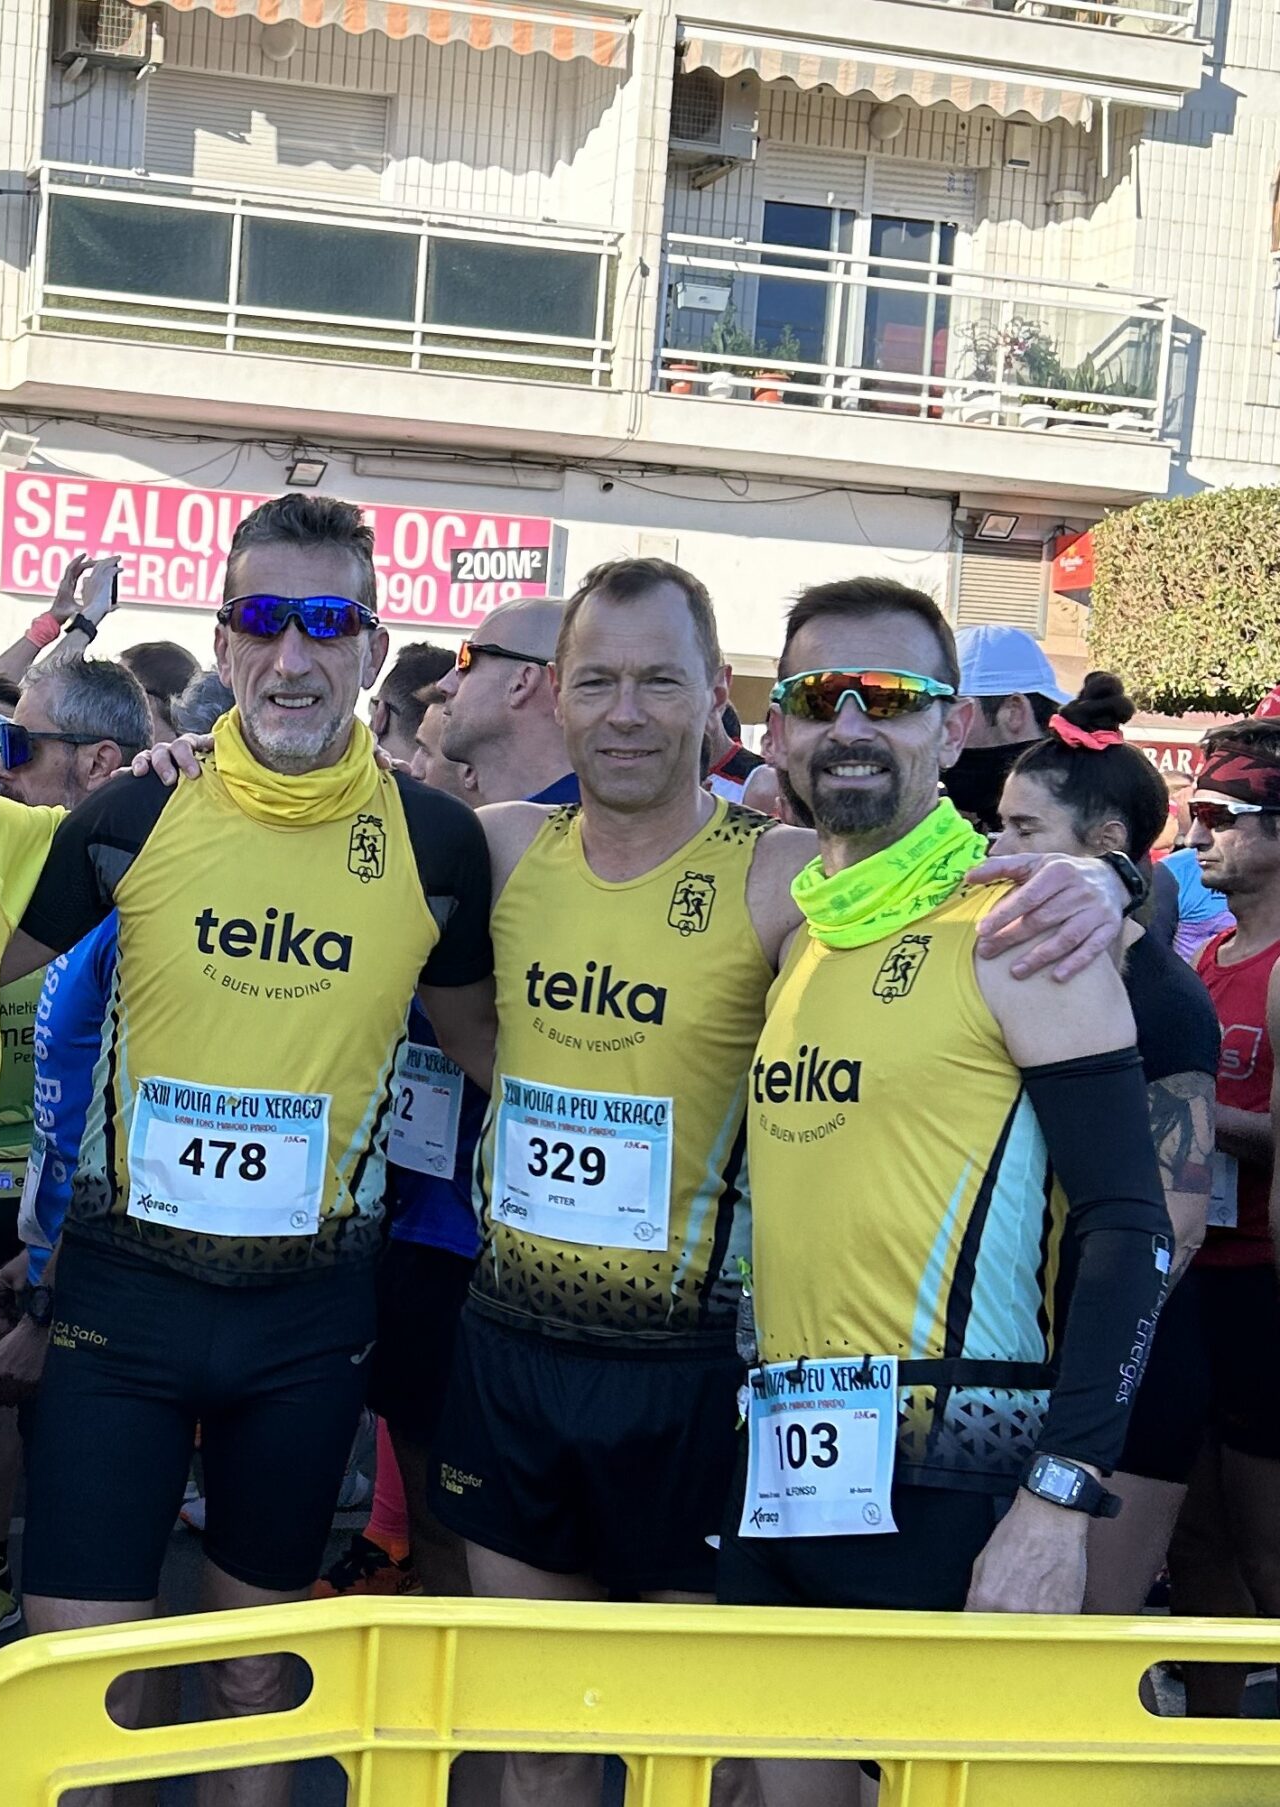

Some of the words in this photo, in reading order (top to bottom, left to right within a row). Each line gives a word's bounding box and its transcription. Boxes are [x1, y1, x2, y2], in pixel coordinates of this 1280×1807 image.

[14, 479, 89, 542] SE
[194, 907, 354, 973] teika
[901, 934, 933, 945] CAS
[202, 963, 218, 981] EL
[221, 975, 260, 997] BUEN
[264, 978, 332, 1000] VENDING
[525, 961, 668, 1026] teika
[532, 1017, 545, 1034] EL
[547, 1028, 582, 1050] BUEN
[586, 1031, 646, 1052] VENDING
[753, 1044, 863, 1104] teika
[174, 1088, 211, 1113] VOLTA
[216, 1094, 225, 1115] A
[232, 1096, 259, 1118] PEU
[265, 1097, 321, 1120] XERACO
[523, 1087, 553, 1114] VOLTA
[558, 1095, 566, 1116] A
[571, 1097, 598, 1120] PEU
[603, 1100, 666, 1127] XERACO
[759, 1113, 769, 1131] EL
[770, 1123, 796, 1144] BUEN
[797, 1113, 846, 1144] VENDING
[178, 1137, 267, 1182] 478
[527, 1137, 607, 1187] 329
[136, 1193, 179, 1214] Xeraco
[548, 1194, 576, 1207] PETER
[55, 1321, 70, 1335] CA
[71, 1324, 108, 1346] Safor
[775, 1422, 839, 1471] 103
[457, 1470, 483, 1488] Safor
[750, 1507, 779, 1529] Xeraco
